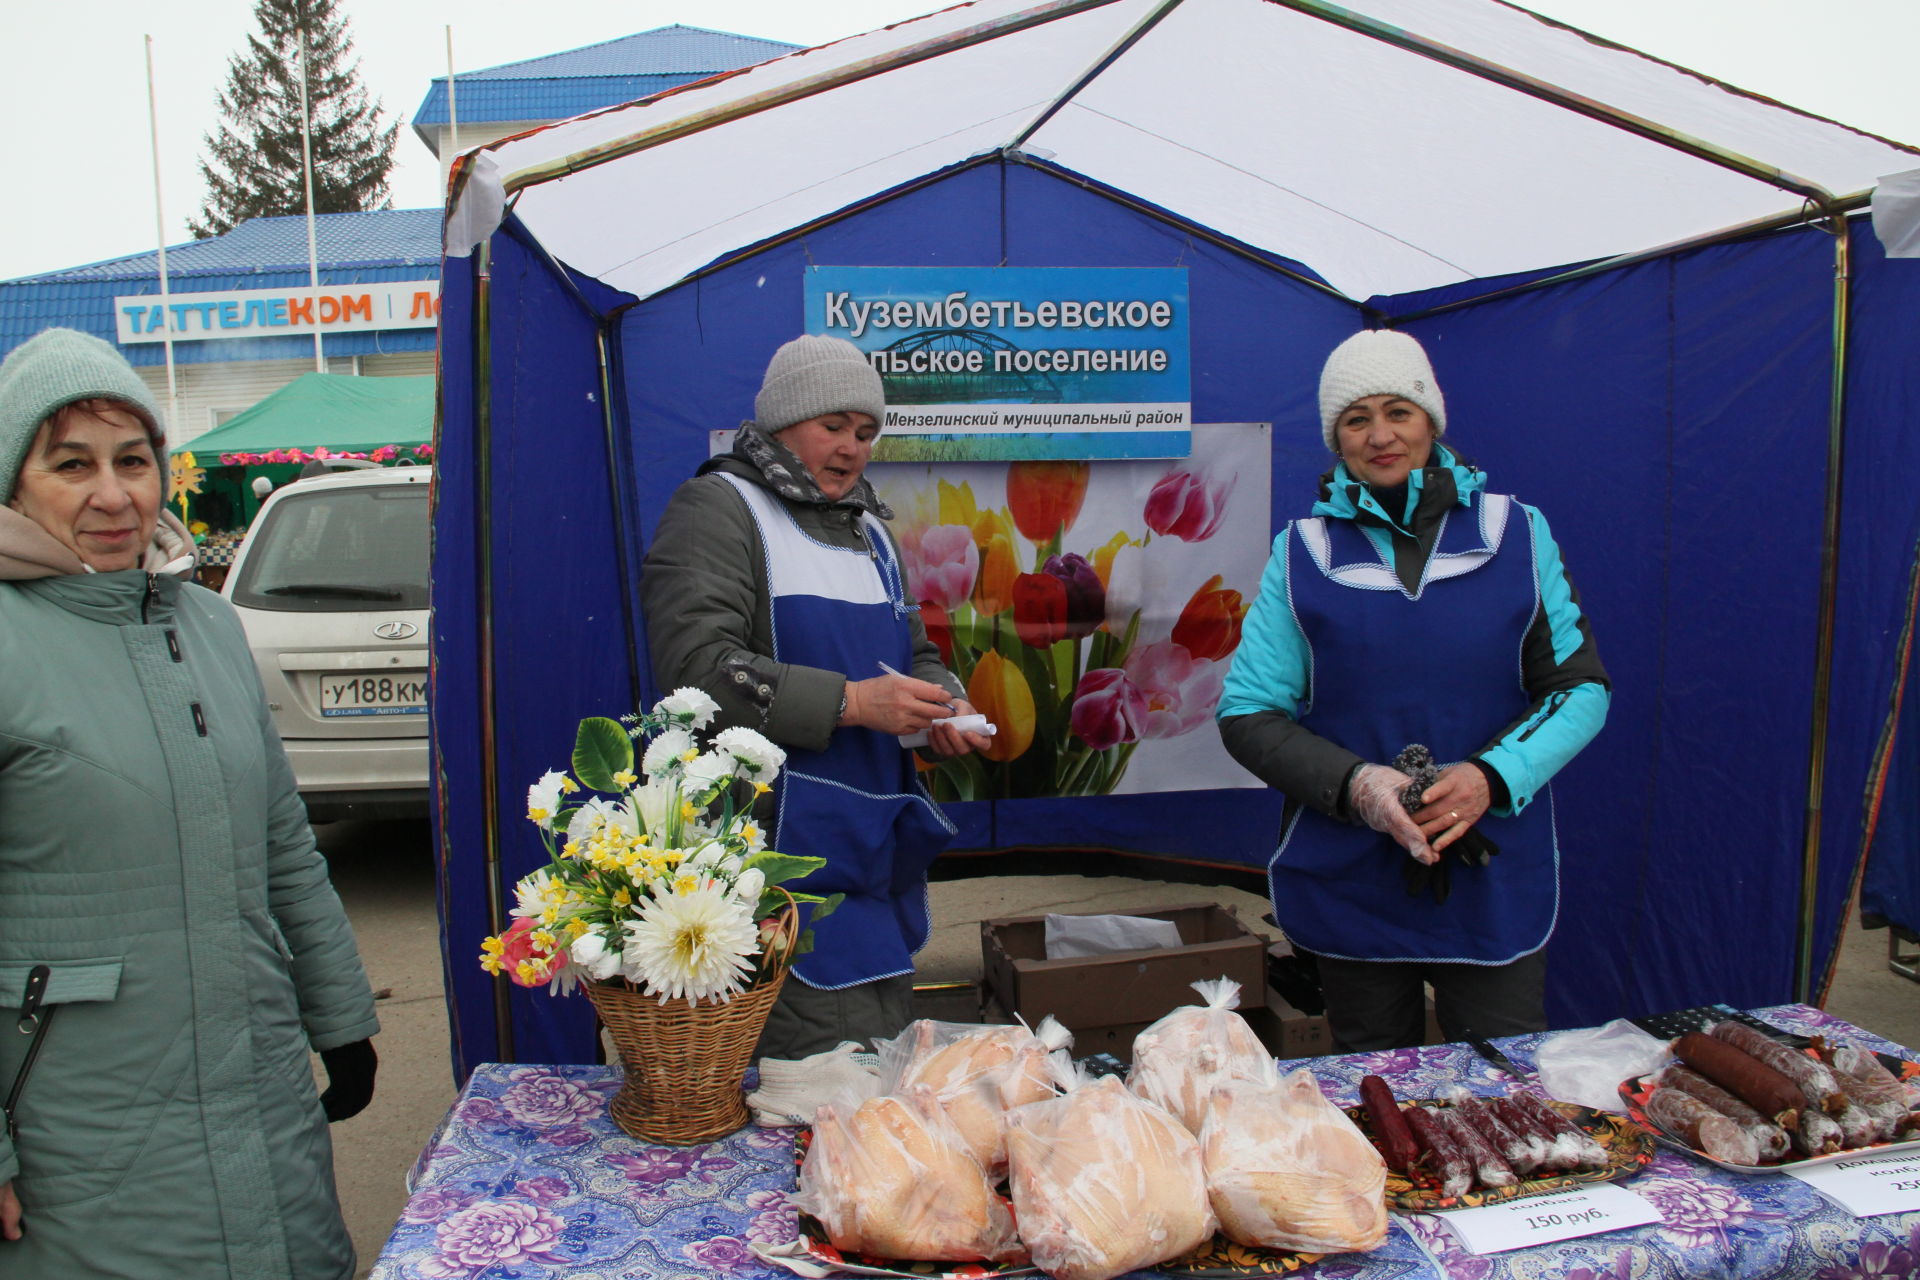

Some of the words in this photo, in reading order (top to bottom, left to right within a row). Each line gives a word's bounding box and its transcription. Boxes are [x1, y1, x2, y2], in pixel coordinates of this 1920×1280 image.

[122, 294, 372, 334] ТАТТЕЛЕКОМ
[826, 291, 1171, 338] Кузембетьевское
[870, 350, 983, 372] льское
[995, 350, 1167, 372] поселение
[885, 411, 998, 427] Мензелинский
[1003, 410, 1131, 429] муниципальный
[1136, 410, 1183, 428] район
[1868, 1165, 1920, 1177] колб
[1508, 1195, 1589, 1211] колбаса
[1525, 1213, 1563, 1230] 150
[1566, 1207, 1610, 1225] руб.
